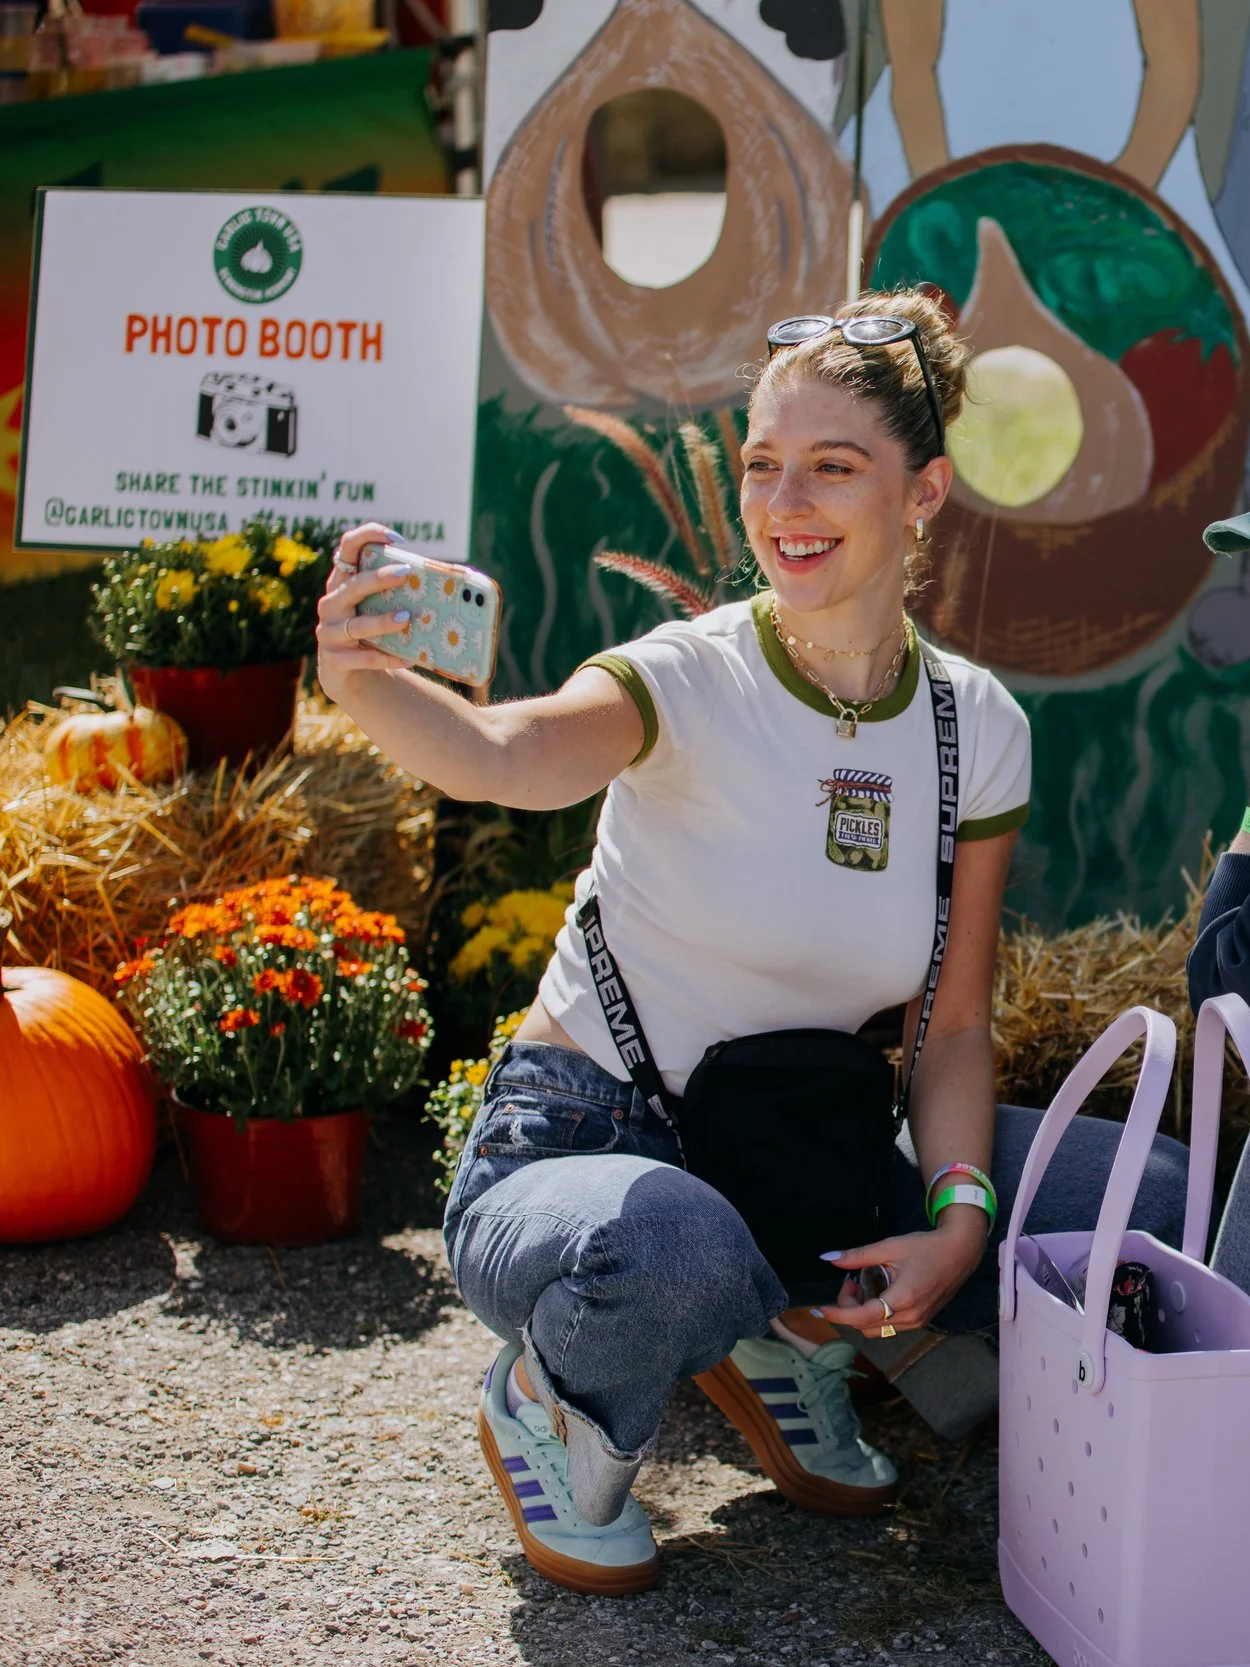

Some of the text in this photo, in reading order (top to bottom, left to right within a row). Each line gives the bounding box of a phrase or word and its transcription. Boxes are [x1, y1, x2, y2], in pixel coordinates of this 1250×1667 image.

[124, 313, 384, 362] PHOTO BOOTH
[115, 470, 376, 503] SHARE THE STINKIN' FUN
[921, 656, 959, 864] SUPREME
[840, 817, 880, 837] PICKLES
